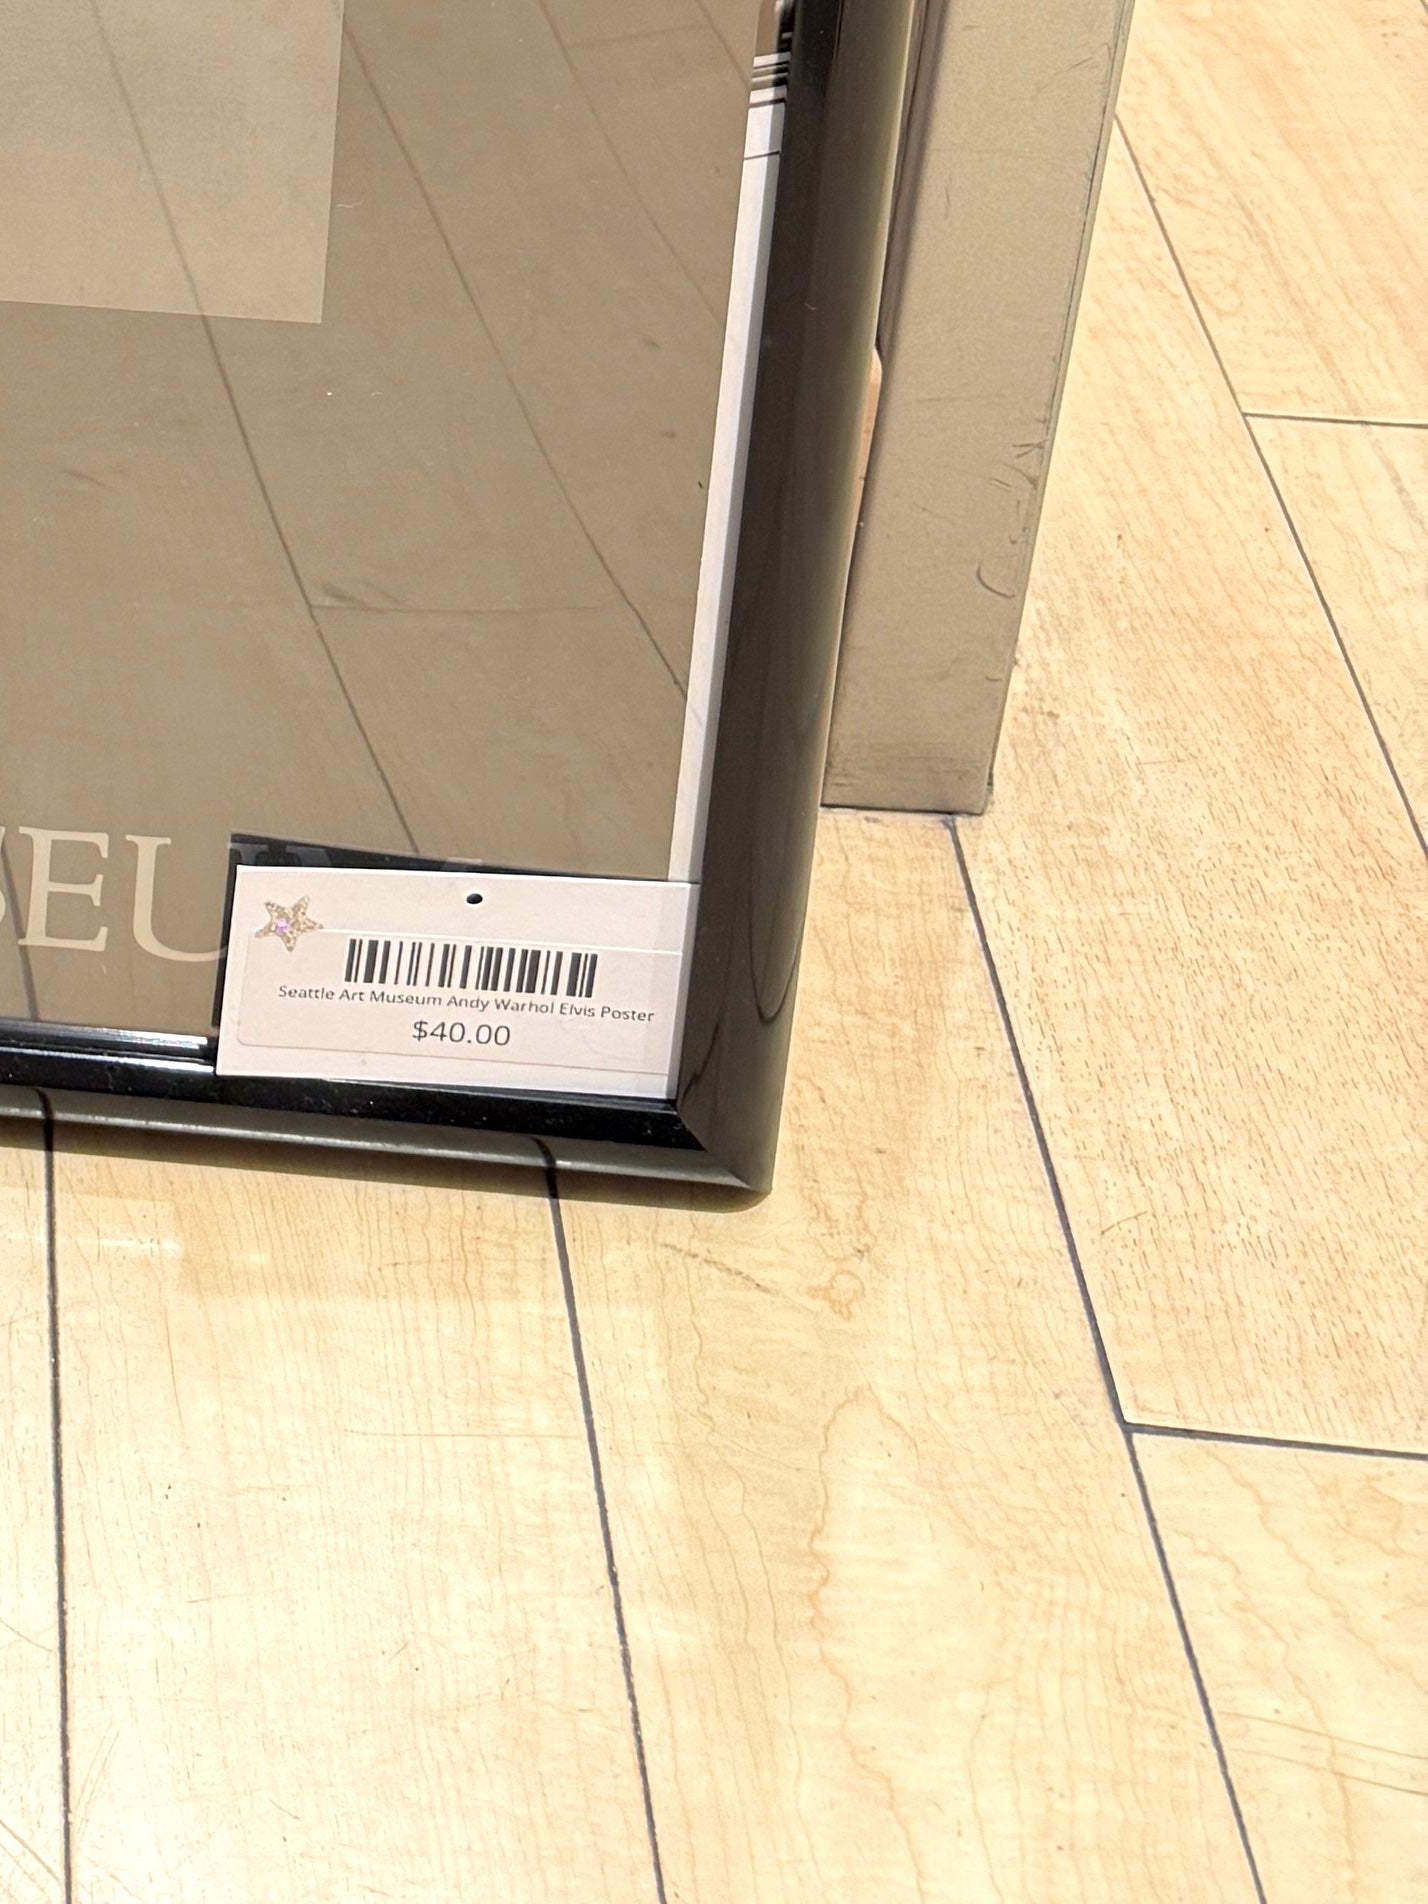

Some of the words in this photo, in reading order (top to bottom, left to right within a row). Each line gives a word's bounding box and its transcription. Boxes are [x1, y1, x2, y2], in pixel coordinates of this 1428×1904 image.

[278, 985, 335, 1002] Seattle
[338, 989, 365, 1003] Art
[370, 992, 442, 1008] Museum
[446, 995, 490, 1013] Andy
[494, 999, 554, 1015] Warhol
[559, 1003, 596, 1019] Elvis
[600, 1007, 655, 1024] Poster
[412, 1020, 512, 1047] $40.00
